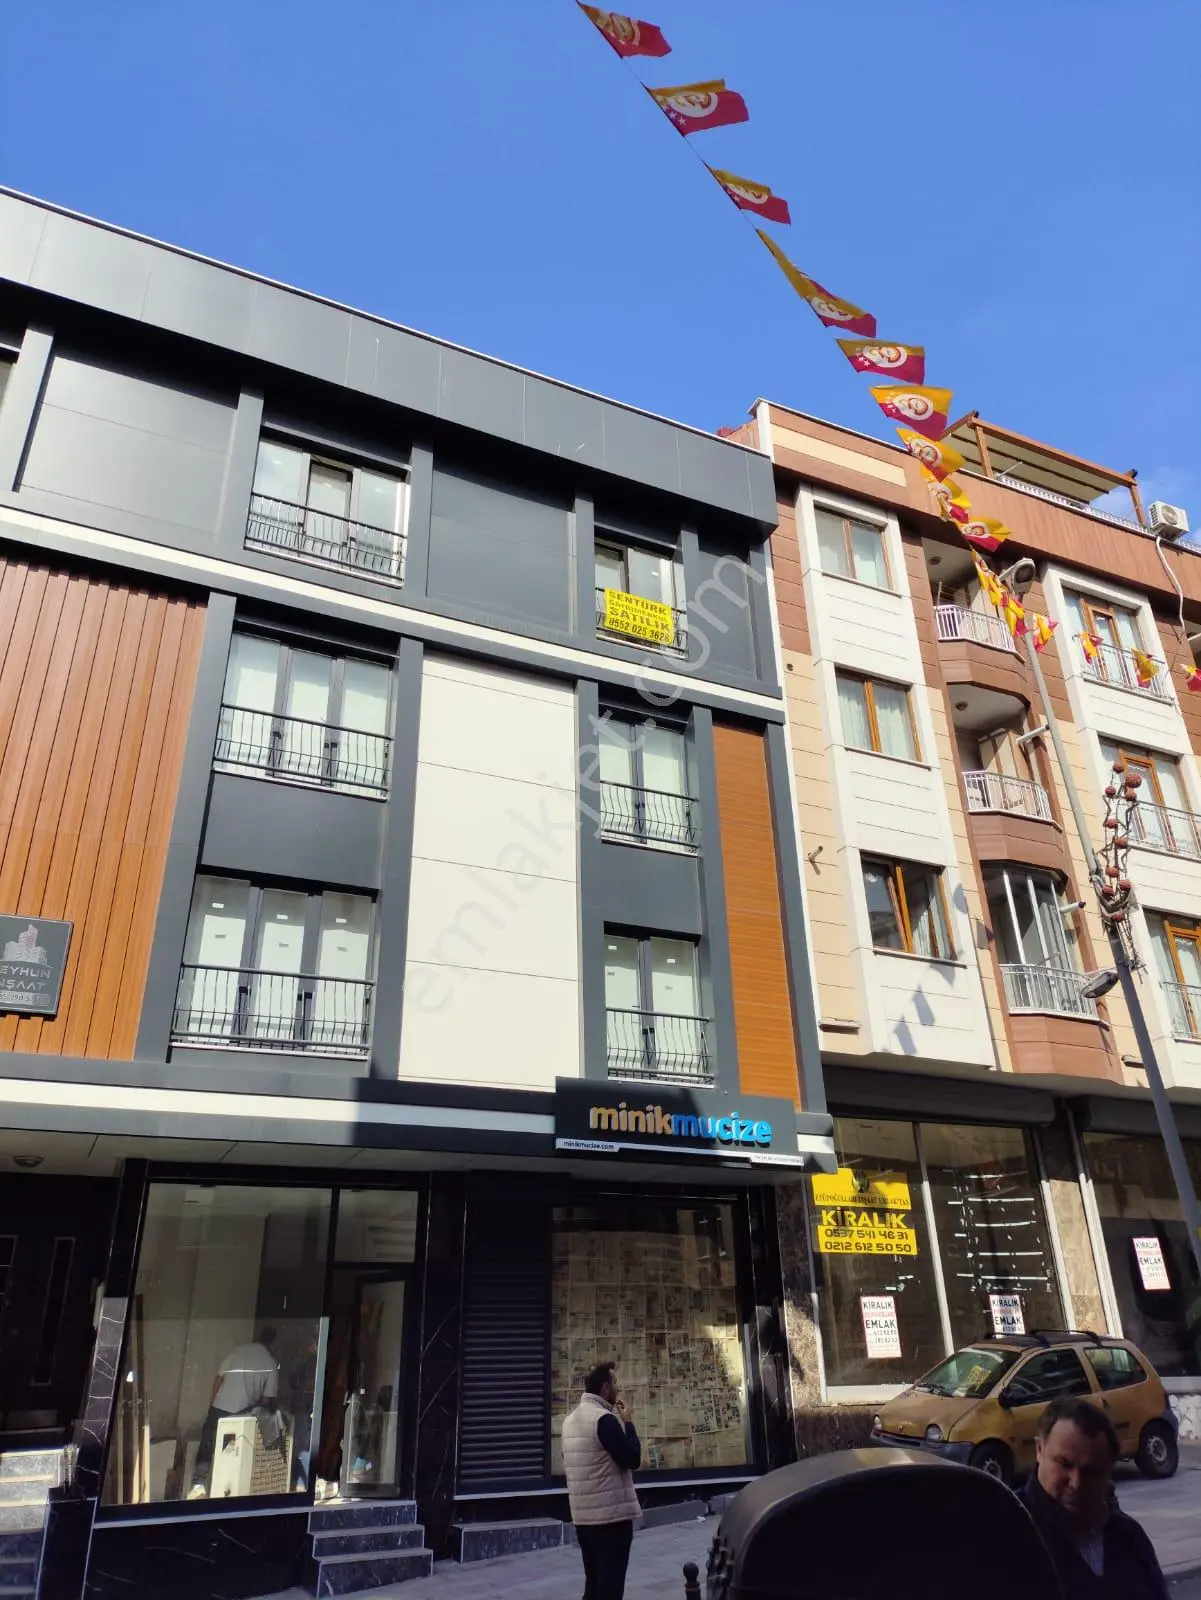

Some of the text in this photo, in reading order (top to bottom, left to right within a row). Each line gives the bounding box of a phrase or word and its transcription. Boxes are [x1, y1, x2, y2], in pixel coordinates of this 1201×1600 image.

[609, 606, 670, 632] SATILIK
[608, 617, 630, 631] 0552
[631, 623, 648, 636] 025
[589, 1101, 773, 1144] minikmucize
[821, 1206, 908, 1229] KİRALIK
[825, 1228, 855, 1239] 0537
[856, 1229, 876, 1240] 541
[897, 1231, 909, 1240] 31
[824, 1241, 912, 1253] 0212 612 50 50
[1139, 1257, 1163, 1265] EMLAK
[865, 1319, 896, 1329] EMLAK
[994, 1315, 1022, 1325] EMLAK
